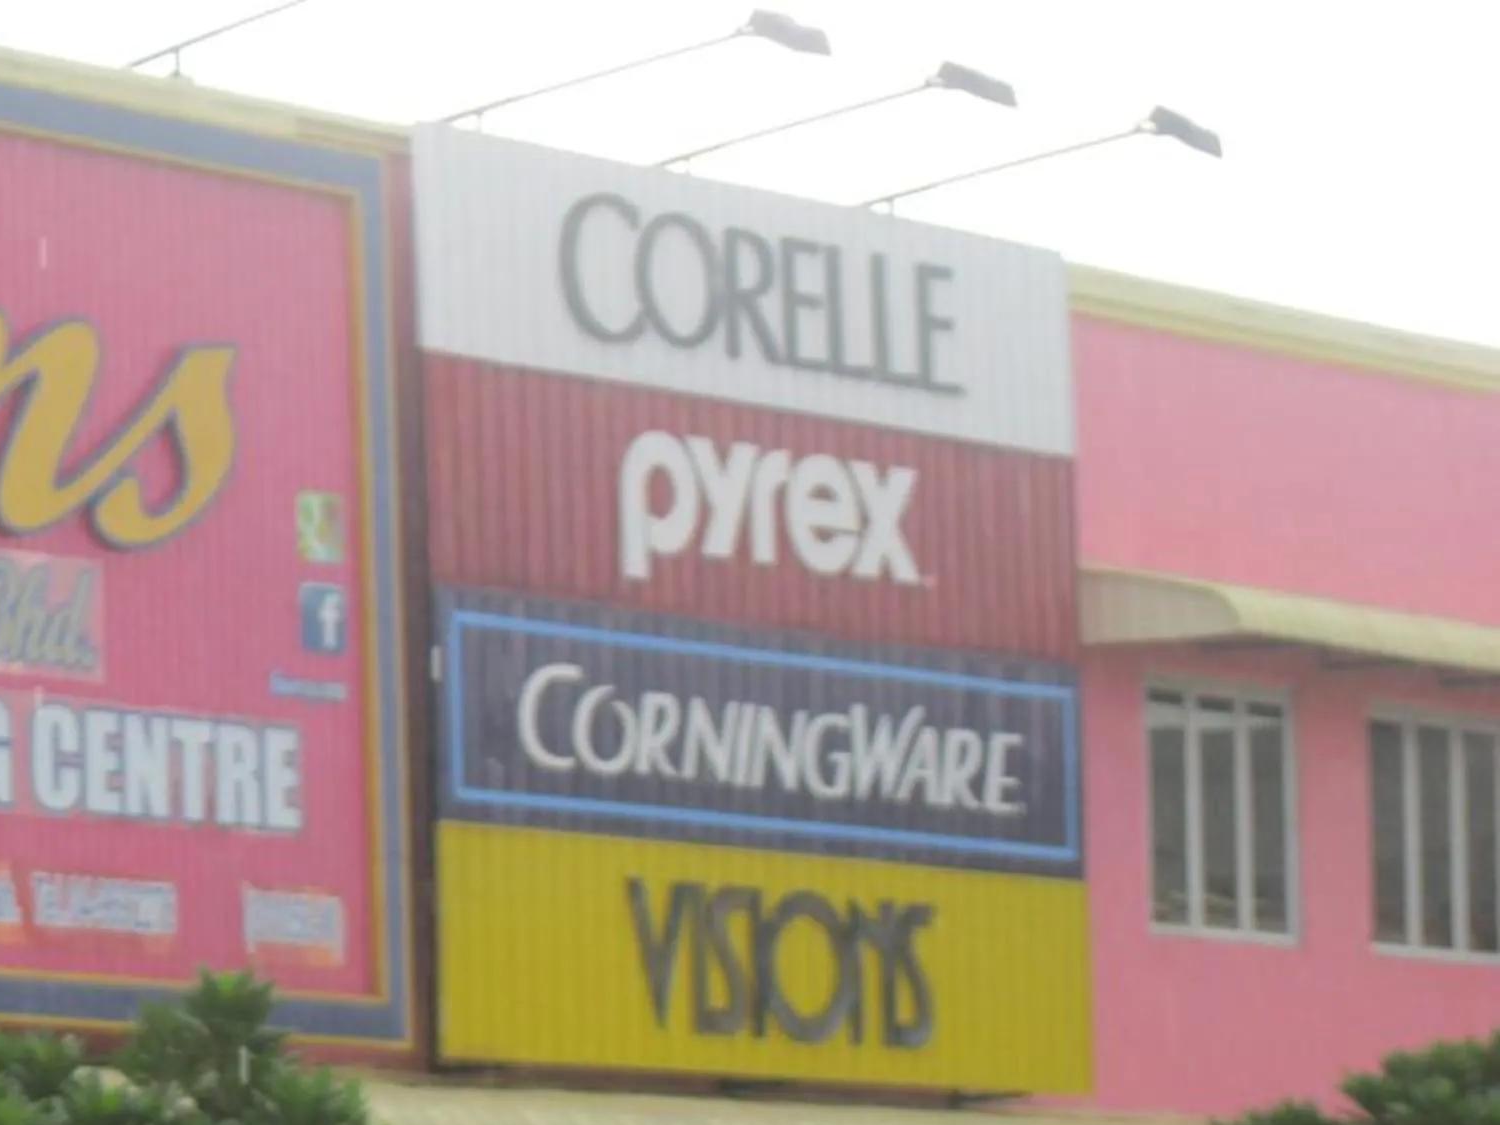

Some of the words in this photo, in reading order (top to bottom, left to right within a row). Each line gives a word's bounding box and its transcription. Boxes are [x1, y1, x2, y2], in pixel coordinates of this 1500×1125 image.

[557, 191, 967, 398] CORELLE
[618, 430, 924, 586] pyrex
[31, 702, 303, 831] CENTRE
[624, 874, 941, 1052] VISIONS
